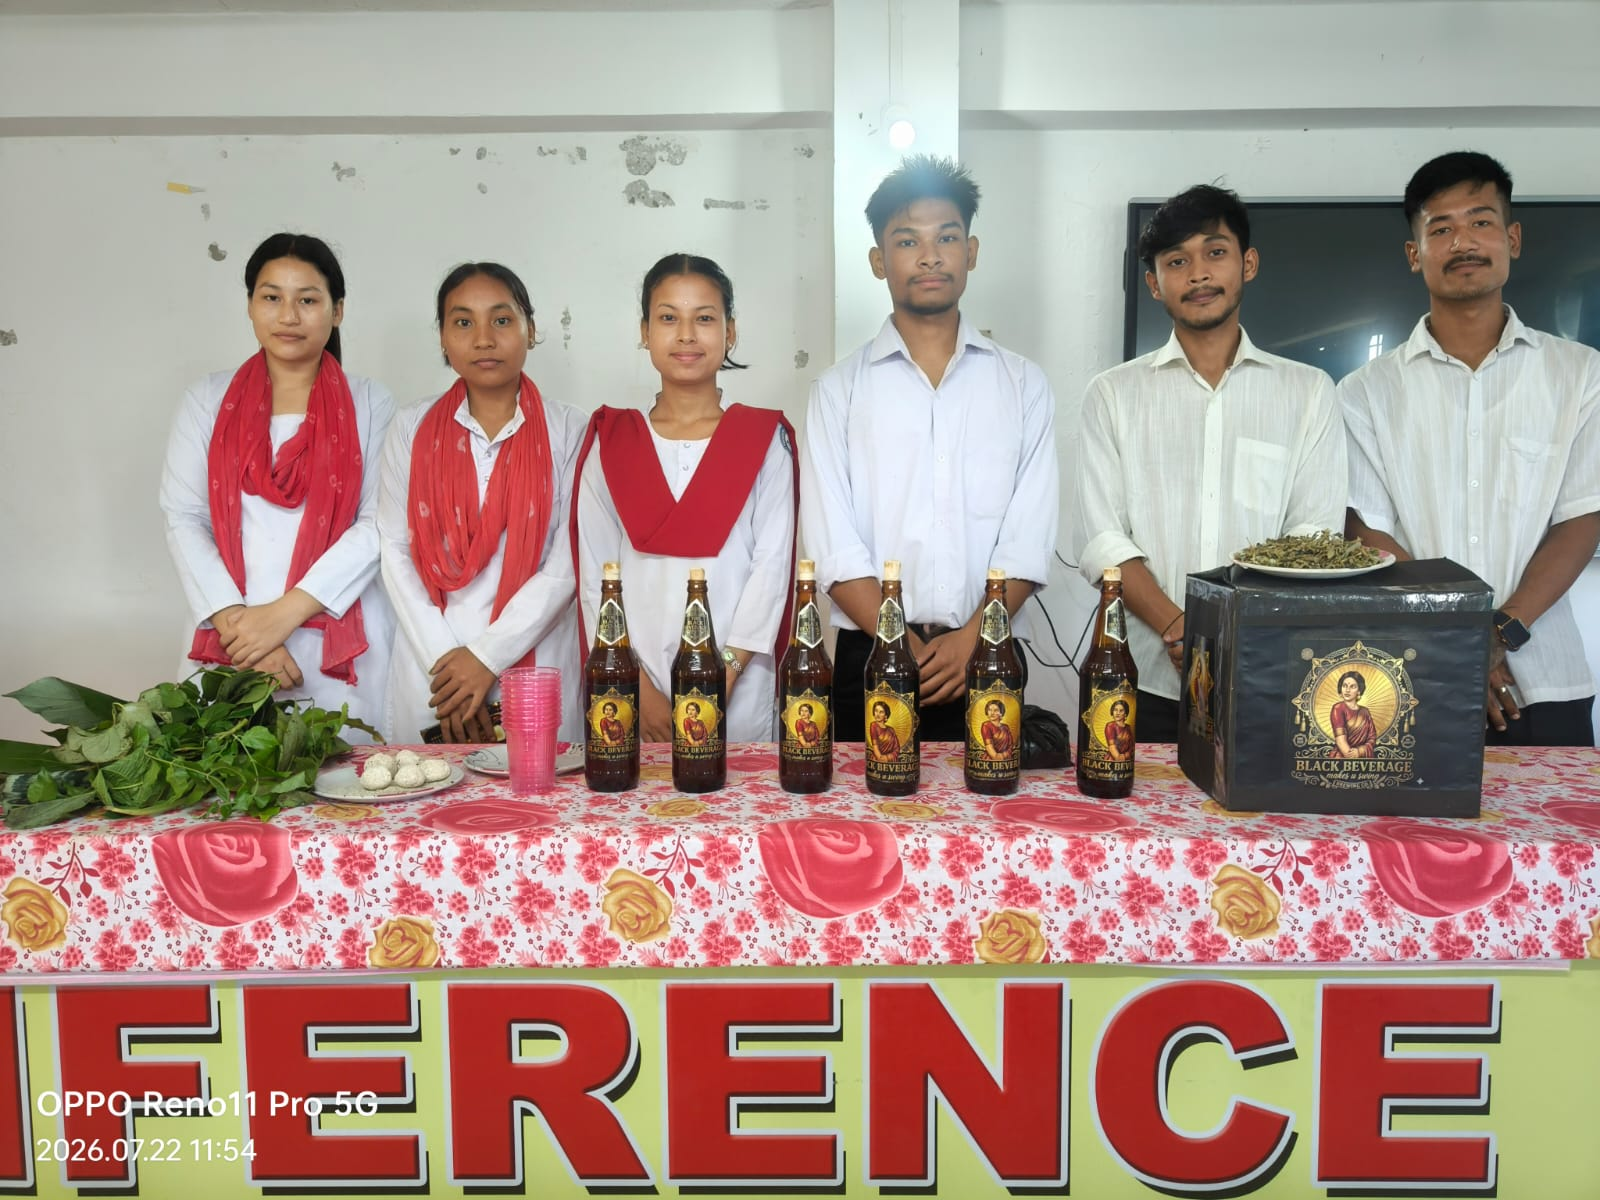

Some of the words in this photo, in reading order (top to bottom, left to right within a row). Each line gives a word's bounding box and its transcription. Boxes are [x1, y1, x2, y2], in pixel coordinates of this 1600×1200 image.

[968, 759, 990, 770] LACK
[1082, 758, 1112, 771] BLACK
[1296, 760, 1340, 772] BLACK
[1343, 761, 1412, 773] BEVERAGE
[0, 978, 1502, 1198] FERENCE
